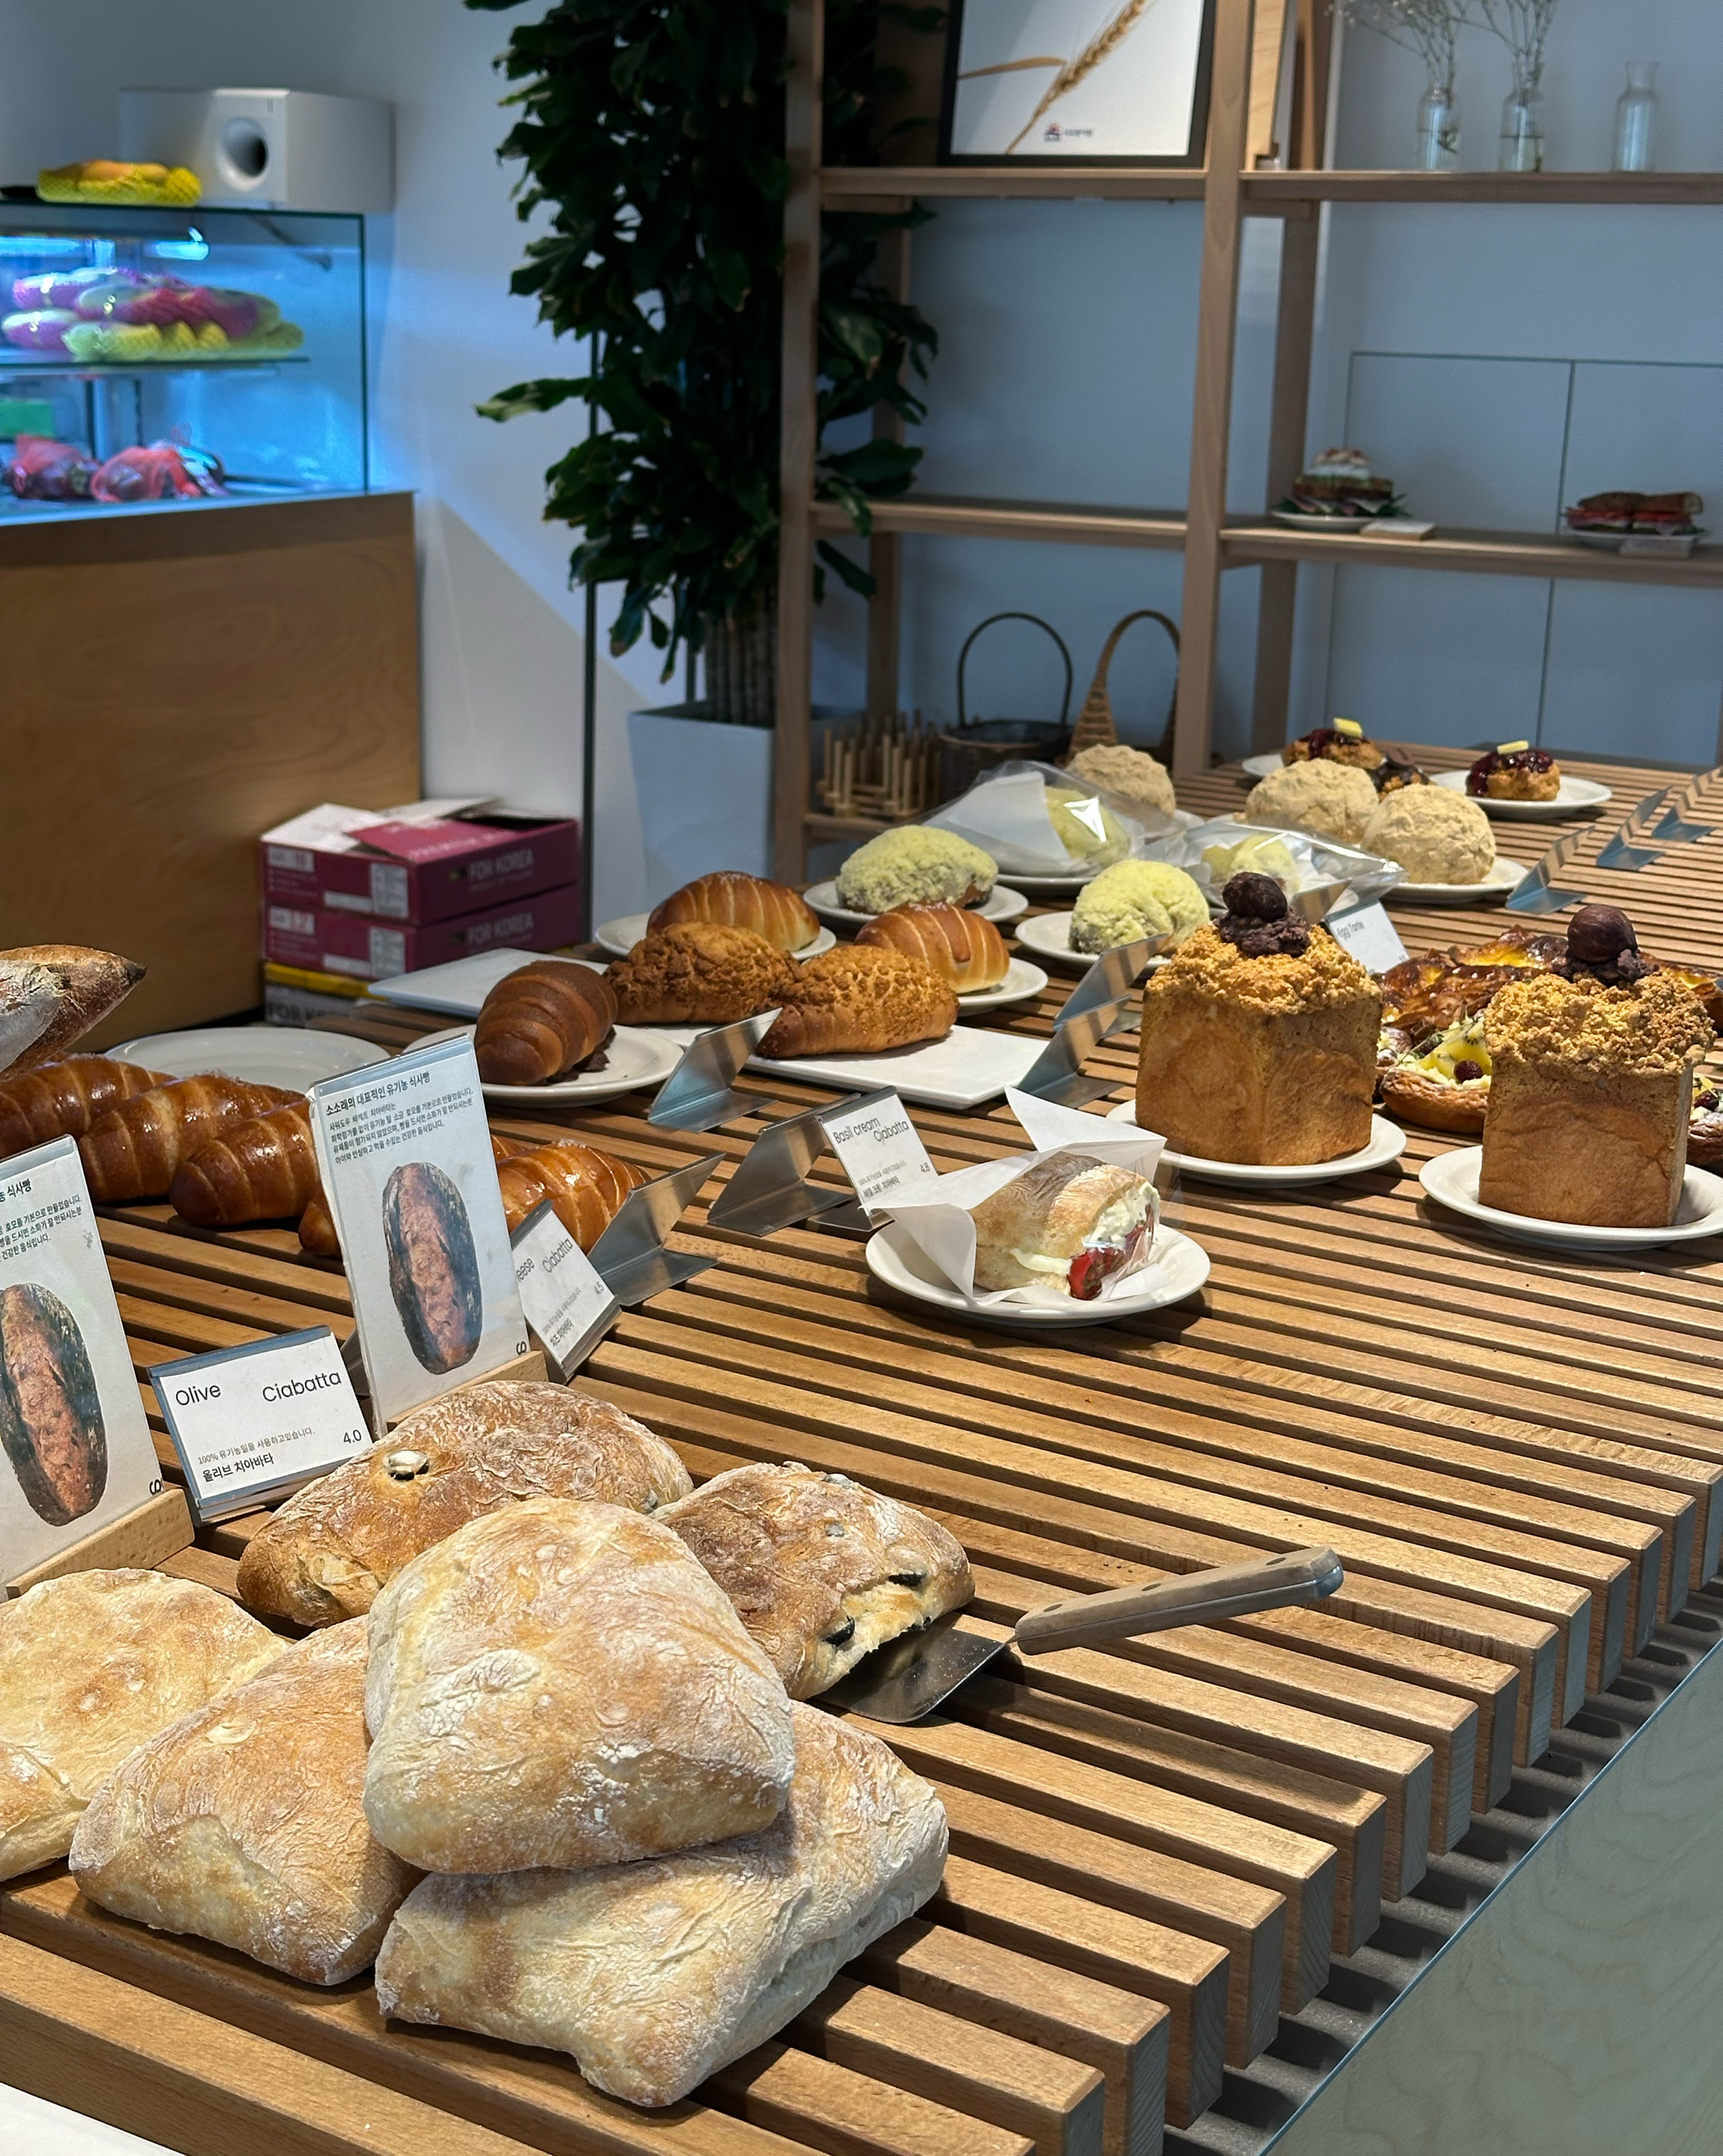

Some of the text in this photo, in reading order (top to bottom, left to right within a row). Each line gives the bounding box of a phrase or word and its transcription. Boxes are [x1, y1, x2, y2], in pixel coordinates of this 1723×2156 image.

[470, 859, 493, 881] FOR
[326, 1070, 430, 1116] 소소래의 대표적인 유기농 식사빵
[422, 1098, 442, 1111] 기본으로
[411, 1114, 426, 1125] 드시면
[833, 1117, 881, 1143] Basil cream
[873, 1120, 909, 1142] Ciabatta
[7, 1179, 32, 1197] 식사빵
[23, 1208, 46, 1223] 기본으로
[47, 1194, 82, 1214] 만들었습니다.
[11, 1227, 30, 1242] 드시면
[30, 1220, 48, 1235] 소화가
[47, 1217, 54, 1228] 잘
[1, 1232, 52, 1260] 건강한 음식입니다.
[516, 1238, 574, 1283] eese Ciabatta
[175, 1372, 342, 1406] Olive Ciabatta
[343, 1429, 362, 1445] 4.0
[198, 1453, 218, 1465] 100%
[218, 1443, 256, 1459] 유기농밀을
[202, 1452, 274, 1483] 올리브 치아바타
